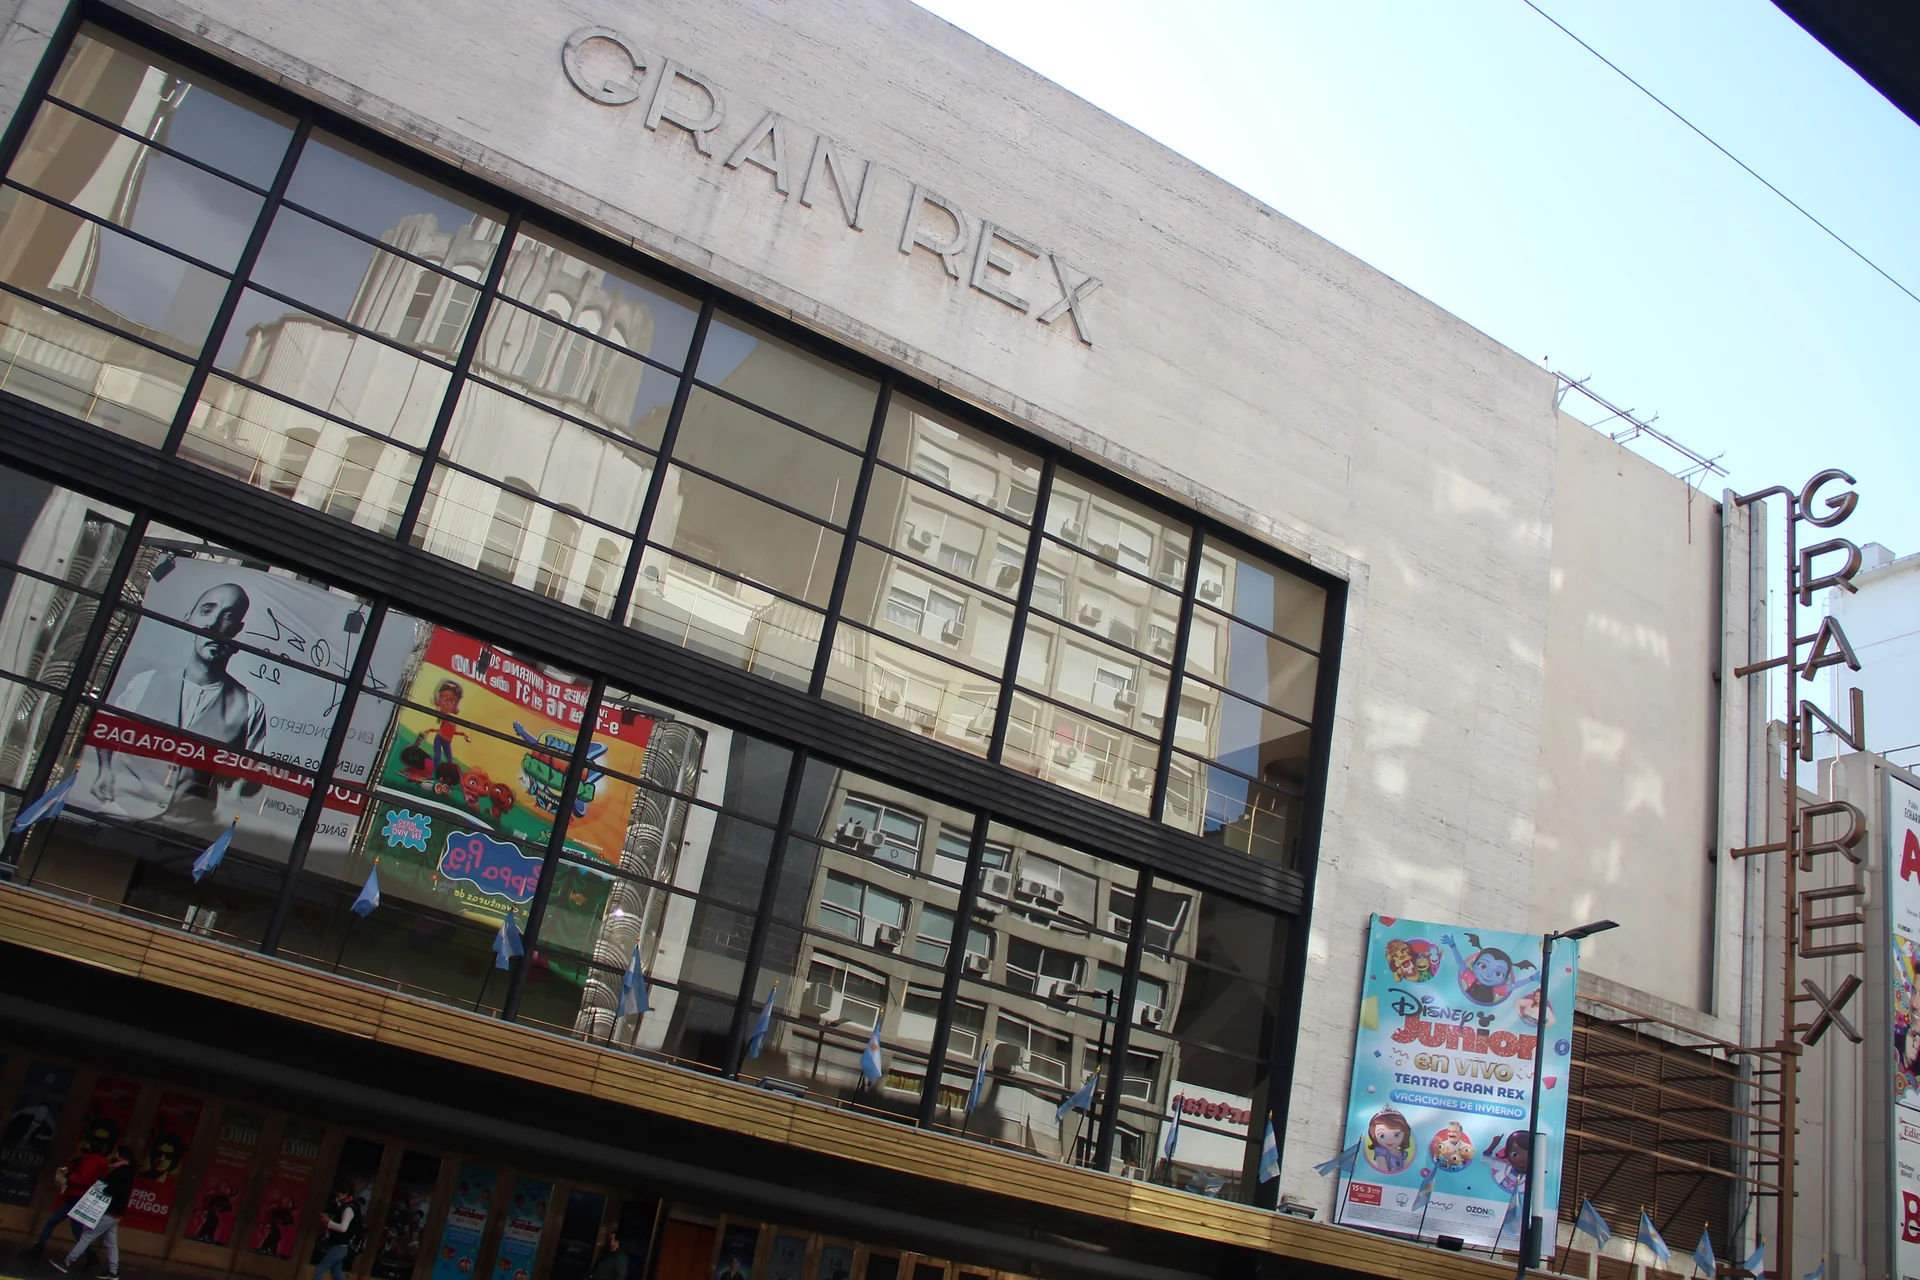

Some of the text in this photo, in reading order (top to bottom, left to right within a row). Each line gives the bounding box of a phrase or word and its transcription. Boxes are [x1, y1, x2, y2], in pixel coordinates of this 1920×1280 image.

[561, 25, 1102, 346] GRAN REX
[1798, 468, 1867, 1046] GRAN REX
[1391, 1014, 1538, 1060] Junior
[1414, 1052, 1514, 1082] en vivo
[1394, 1072, 1525, 1101] TEATRO GRAN REX
[1394, 1091, 1522, 1117] VACACIONES DE INVIERNO
[131, 1188, 157, 1202] PRO
[1351, 1184, 1372, 1194] 15% 3
[127, 1198, 169, 1215] FUGOS
[1465, 1205, 1494, 1216] OZONO
